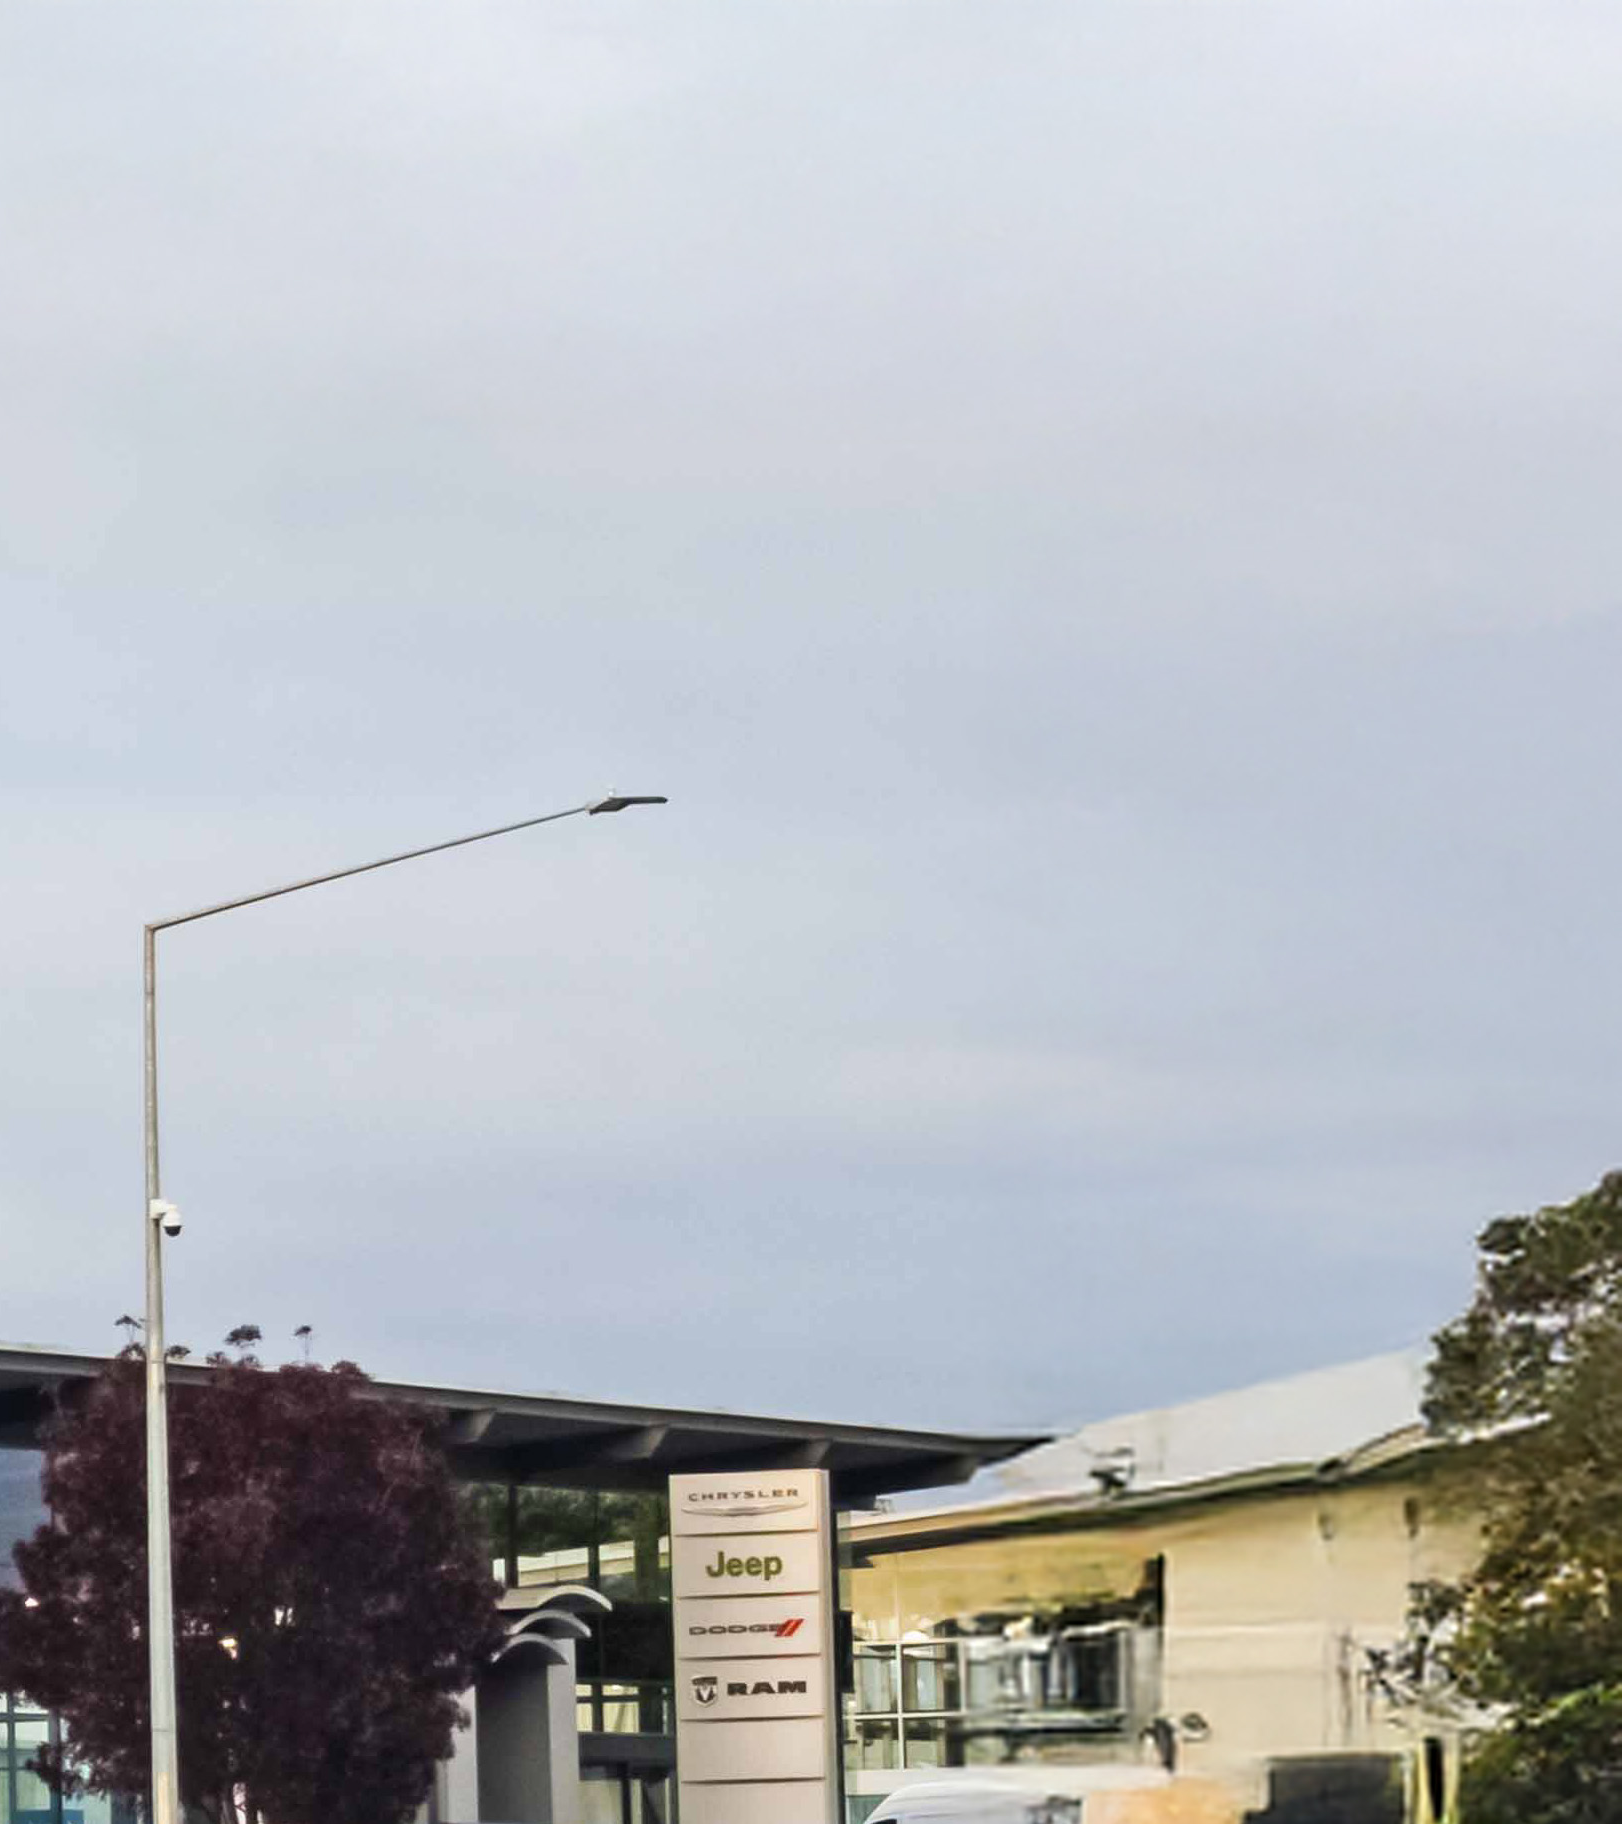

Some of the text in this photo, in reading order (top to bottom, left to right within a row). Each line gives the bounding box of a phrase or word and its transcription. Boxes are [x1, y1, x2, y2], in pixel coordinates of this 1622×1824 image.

[688, 1489, 798, 1502] CHRYSLER
[705, 1551, 783, 1581] Jeep
[689, 1623, 784, 1636] DODGE
[727, 1680, 807, 1696] RAM
